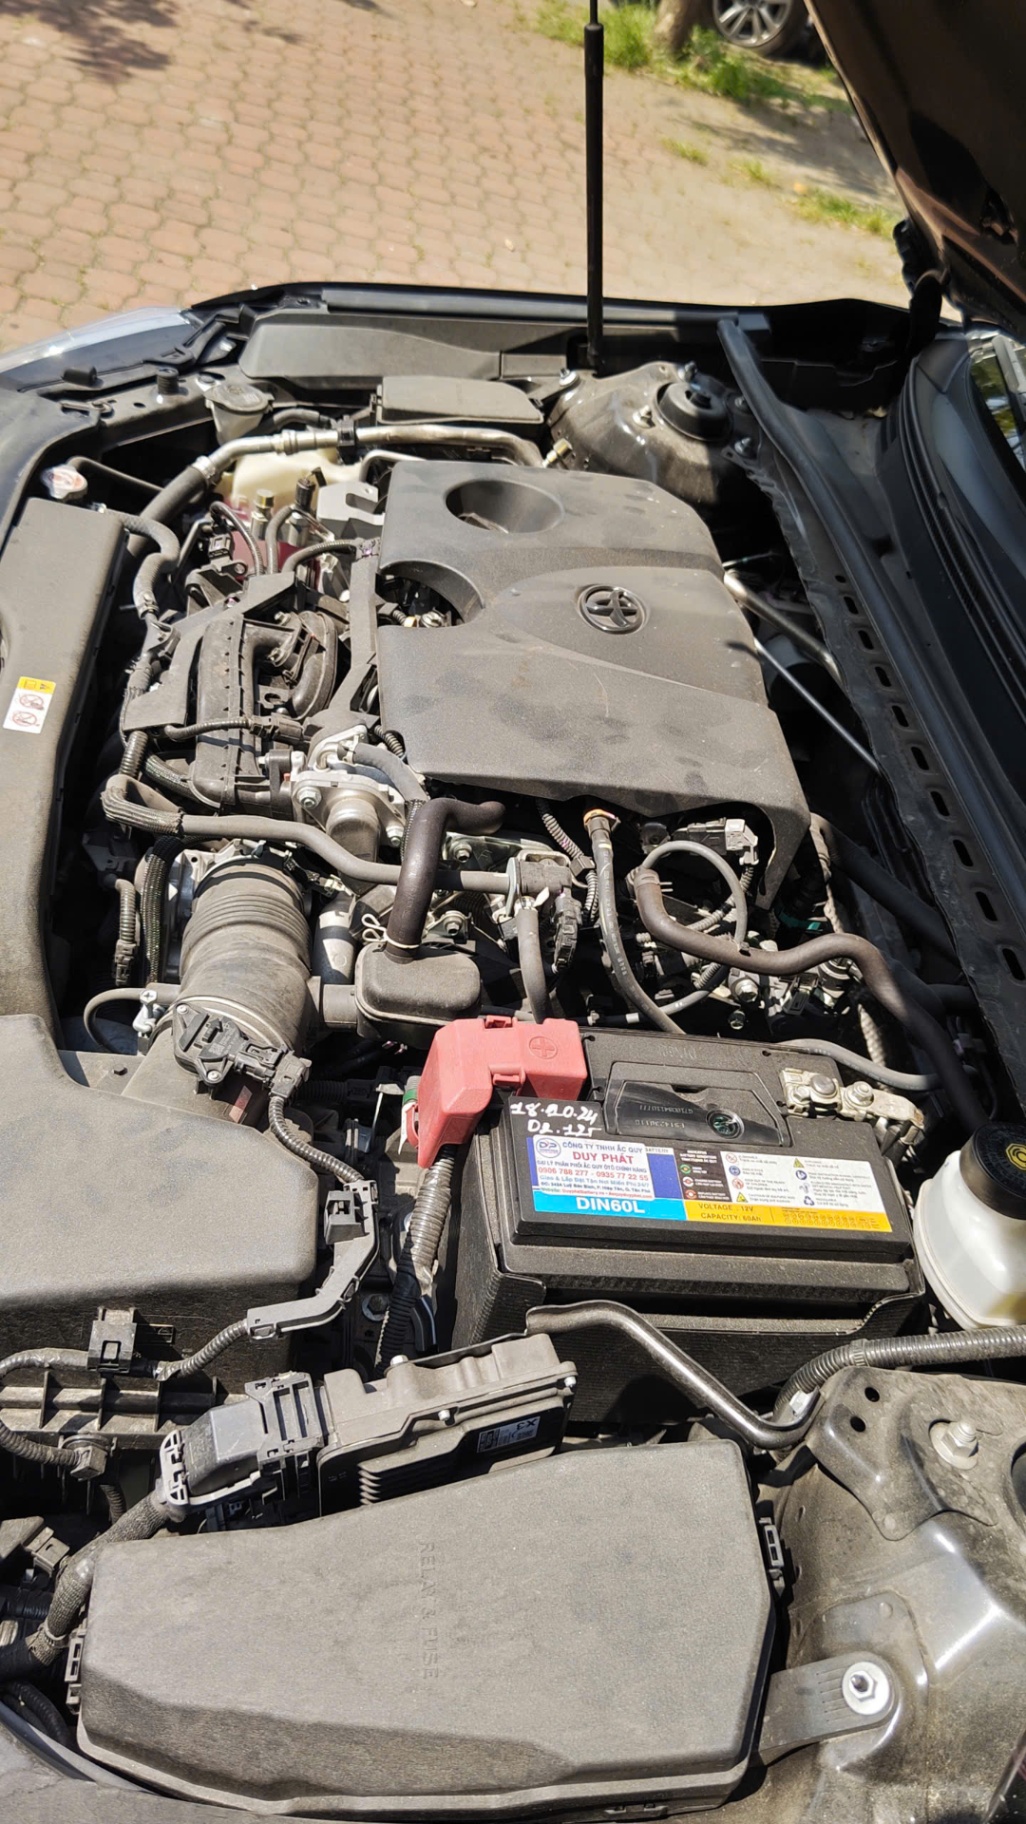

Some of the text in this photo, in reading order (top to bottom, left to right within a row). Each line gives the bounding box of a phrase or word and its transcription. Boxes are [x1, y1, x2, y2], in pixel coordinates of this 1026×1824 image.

[572, 1151, 634, 1164] DUY PHÁT
[576, 1197, 645, 1214] DIN60L
[422, 1628, 439, 1680] FUSE
